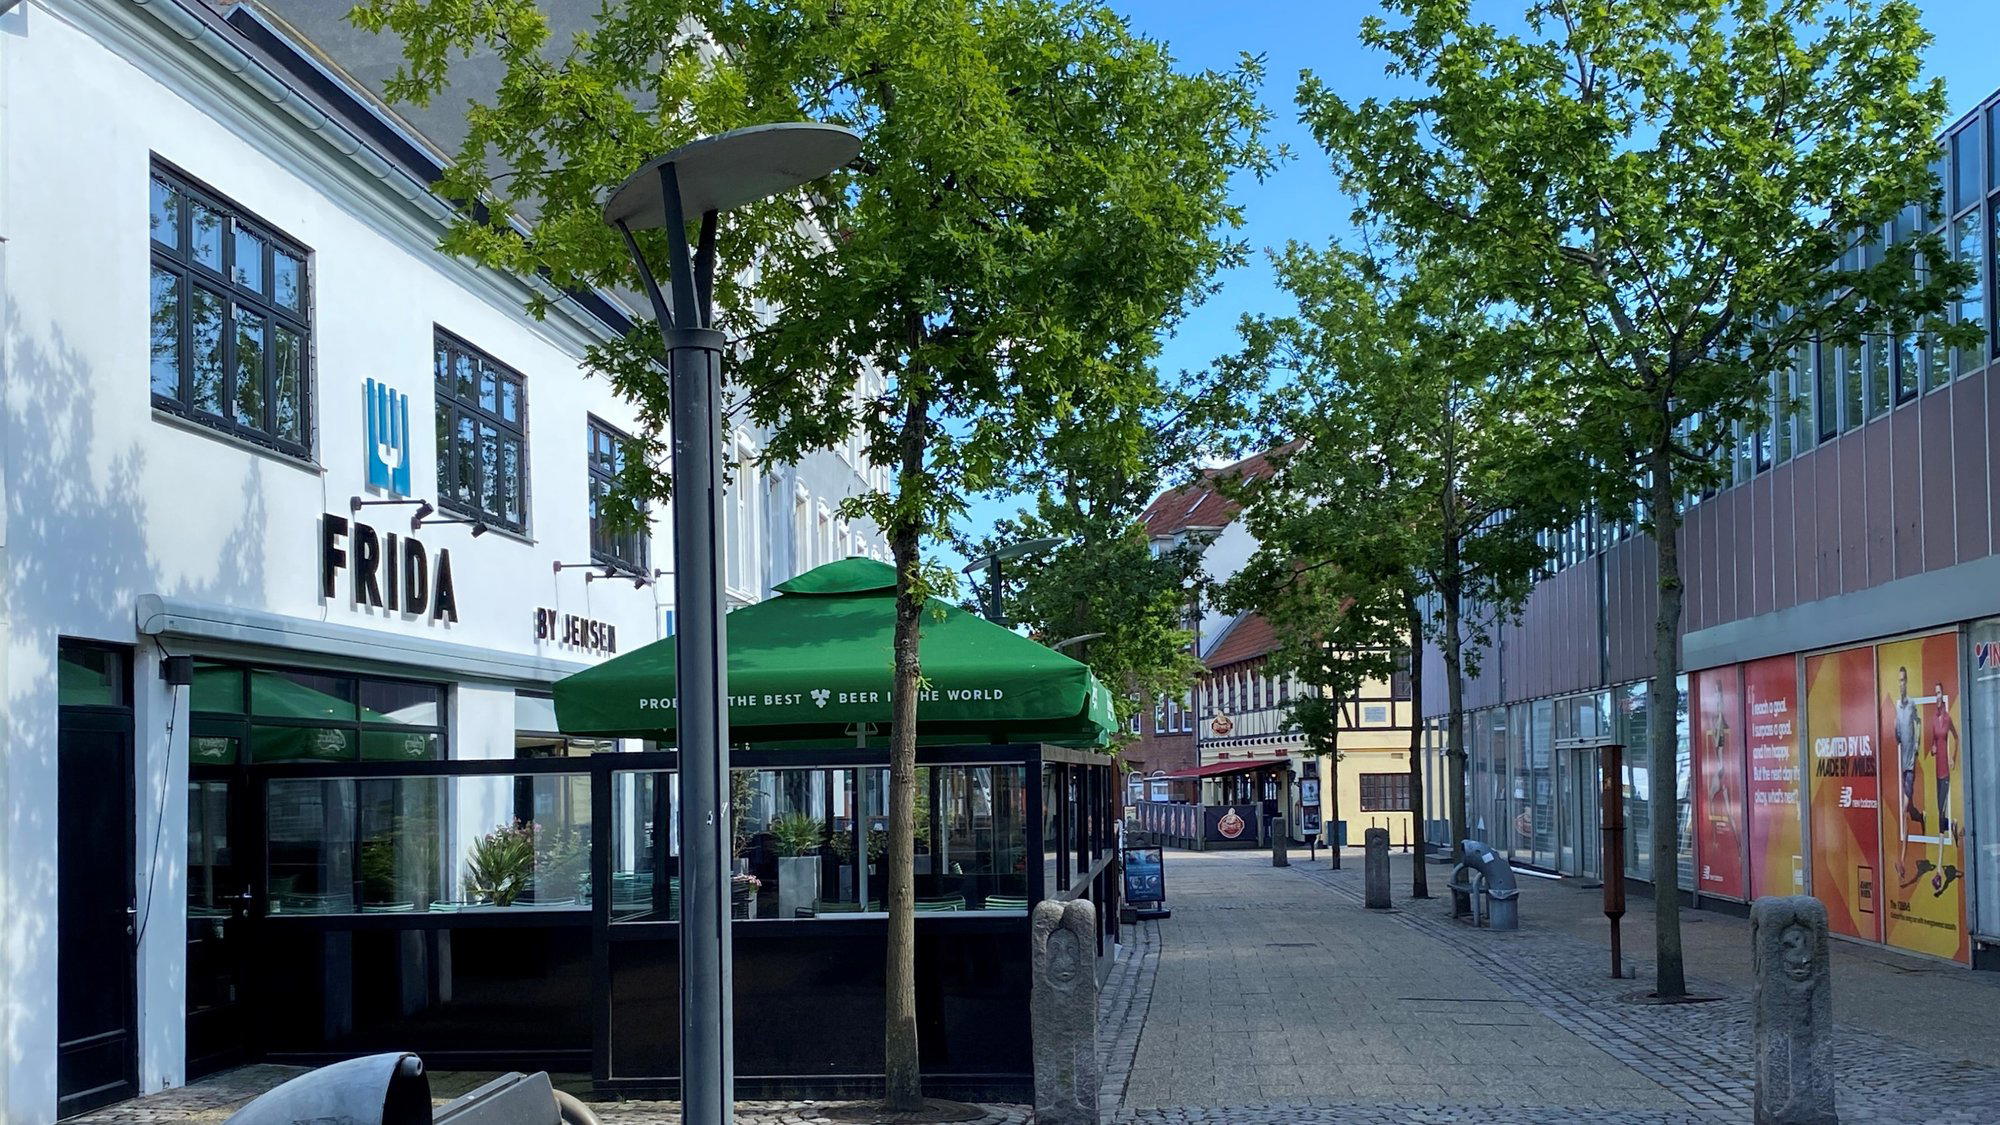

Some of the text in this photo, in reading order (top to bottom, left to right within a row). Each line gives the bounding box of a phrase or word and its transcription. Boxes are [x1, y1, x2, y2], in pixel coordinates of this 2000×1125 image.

[322, 512, 459, 624] FRIDA
[537, 606, 617, 653] BY JENSEN
[727, 695, 757, 707] THE
[764, 693, 801, 706] BEST
[839, 691, 879, 704] BEER
[919, 690, 940, 702] HE
[947, 689, 1004, 701] WORLD
[1815, 736, 1847, 758] CREATED
[1848, 735, 1859, 757] BY
[1815, 758, 1840, 778] MADE
[1840, 758, 1850, 778] BY
